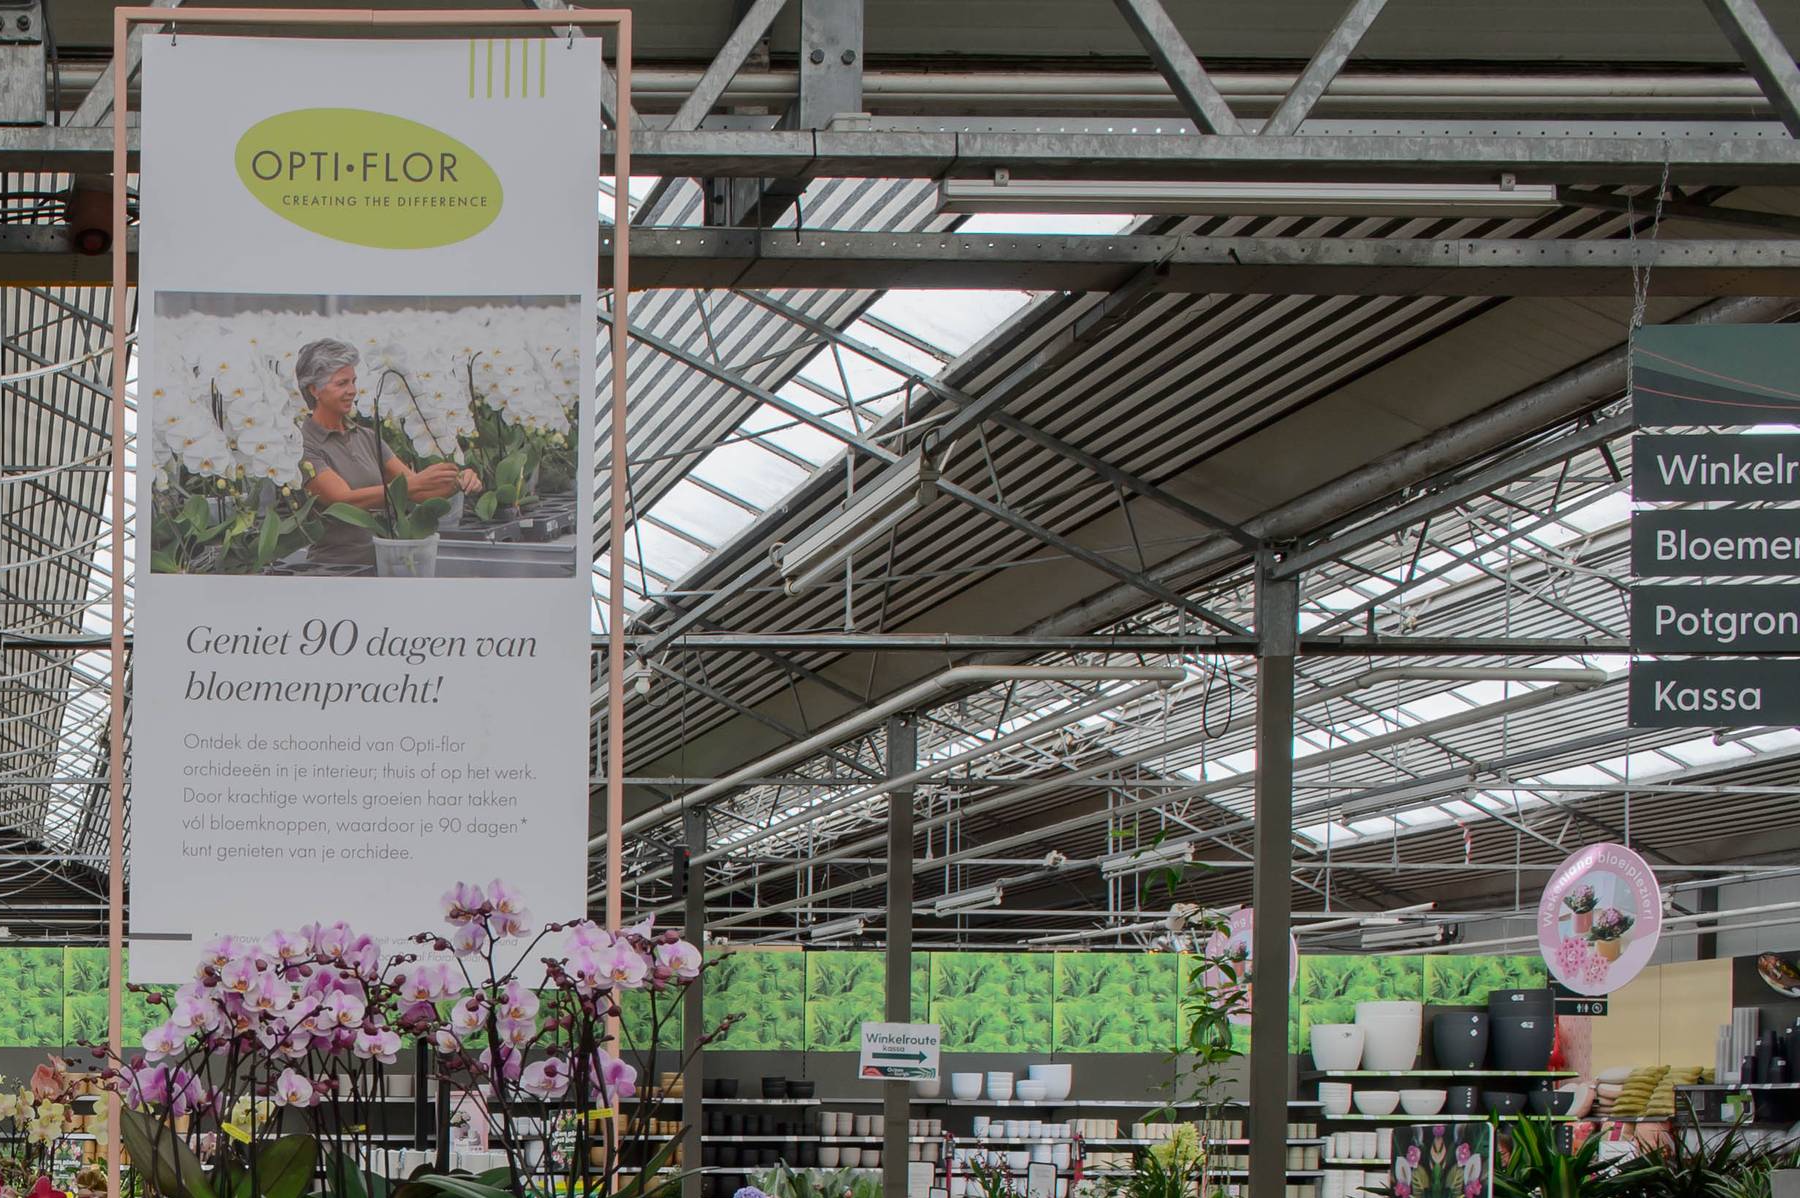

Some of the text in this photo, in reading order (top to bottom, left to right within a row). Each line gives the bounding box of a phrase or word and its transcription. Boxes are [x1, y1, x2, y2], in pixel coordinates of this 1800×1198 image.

[282, 195, 489, 208] CREATING THE DIFFERENCE
[1655, 605, 1798, 643] Potgron
[187, 618, 537, 664] Geniet 90 dagen van
[184, 671, 444, 710] bloemenpracht!
[1655, 680, 1761, 711] Kassa
[183, 733, 466, 757] Ontdek de schoonheid van Opti-flor
[183, 762, 537, 784] orchideeën in je interieur; thuis of op het werk.
[183, 787, 518, 811] Door krachtige wortels groeien haar takken
[182, 814, 205, 831] vól
[210, 815, 331, 838] bloemknoppen,
[336, 816, 414, 834] waardoor
[419, 818, 433, 838] je
[438, 818, 461, 834] 90
[182, 841, 414, 863] kunt genieten van je orchidee.
[866, 1033, 937, 1046] Winkelroute
